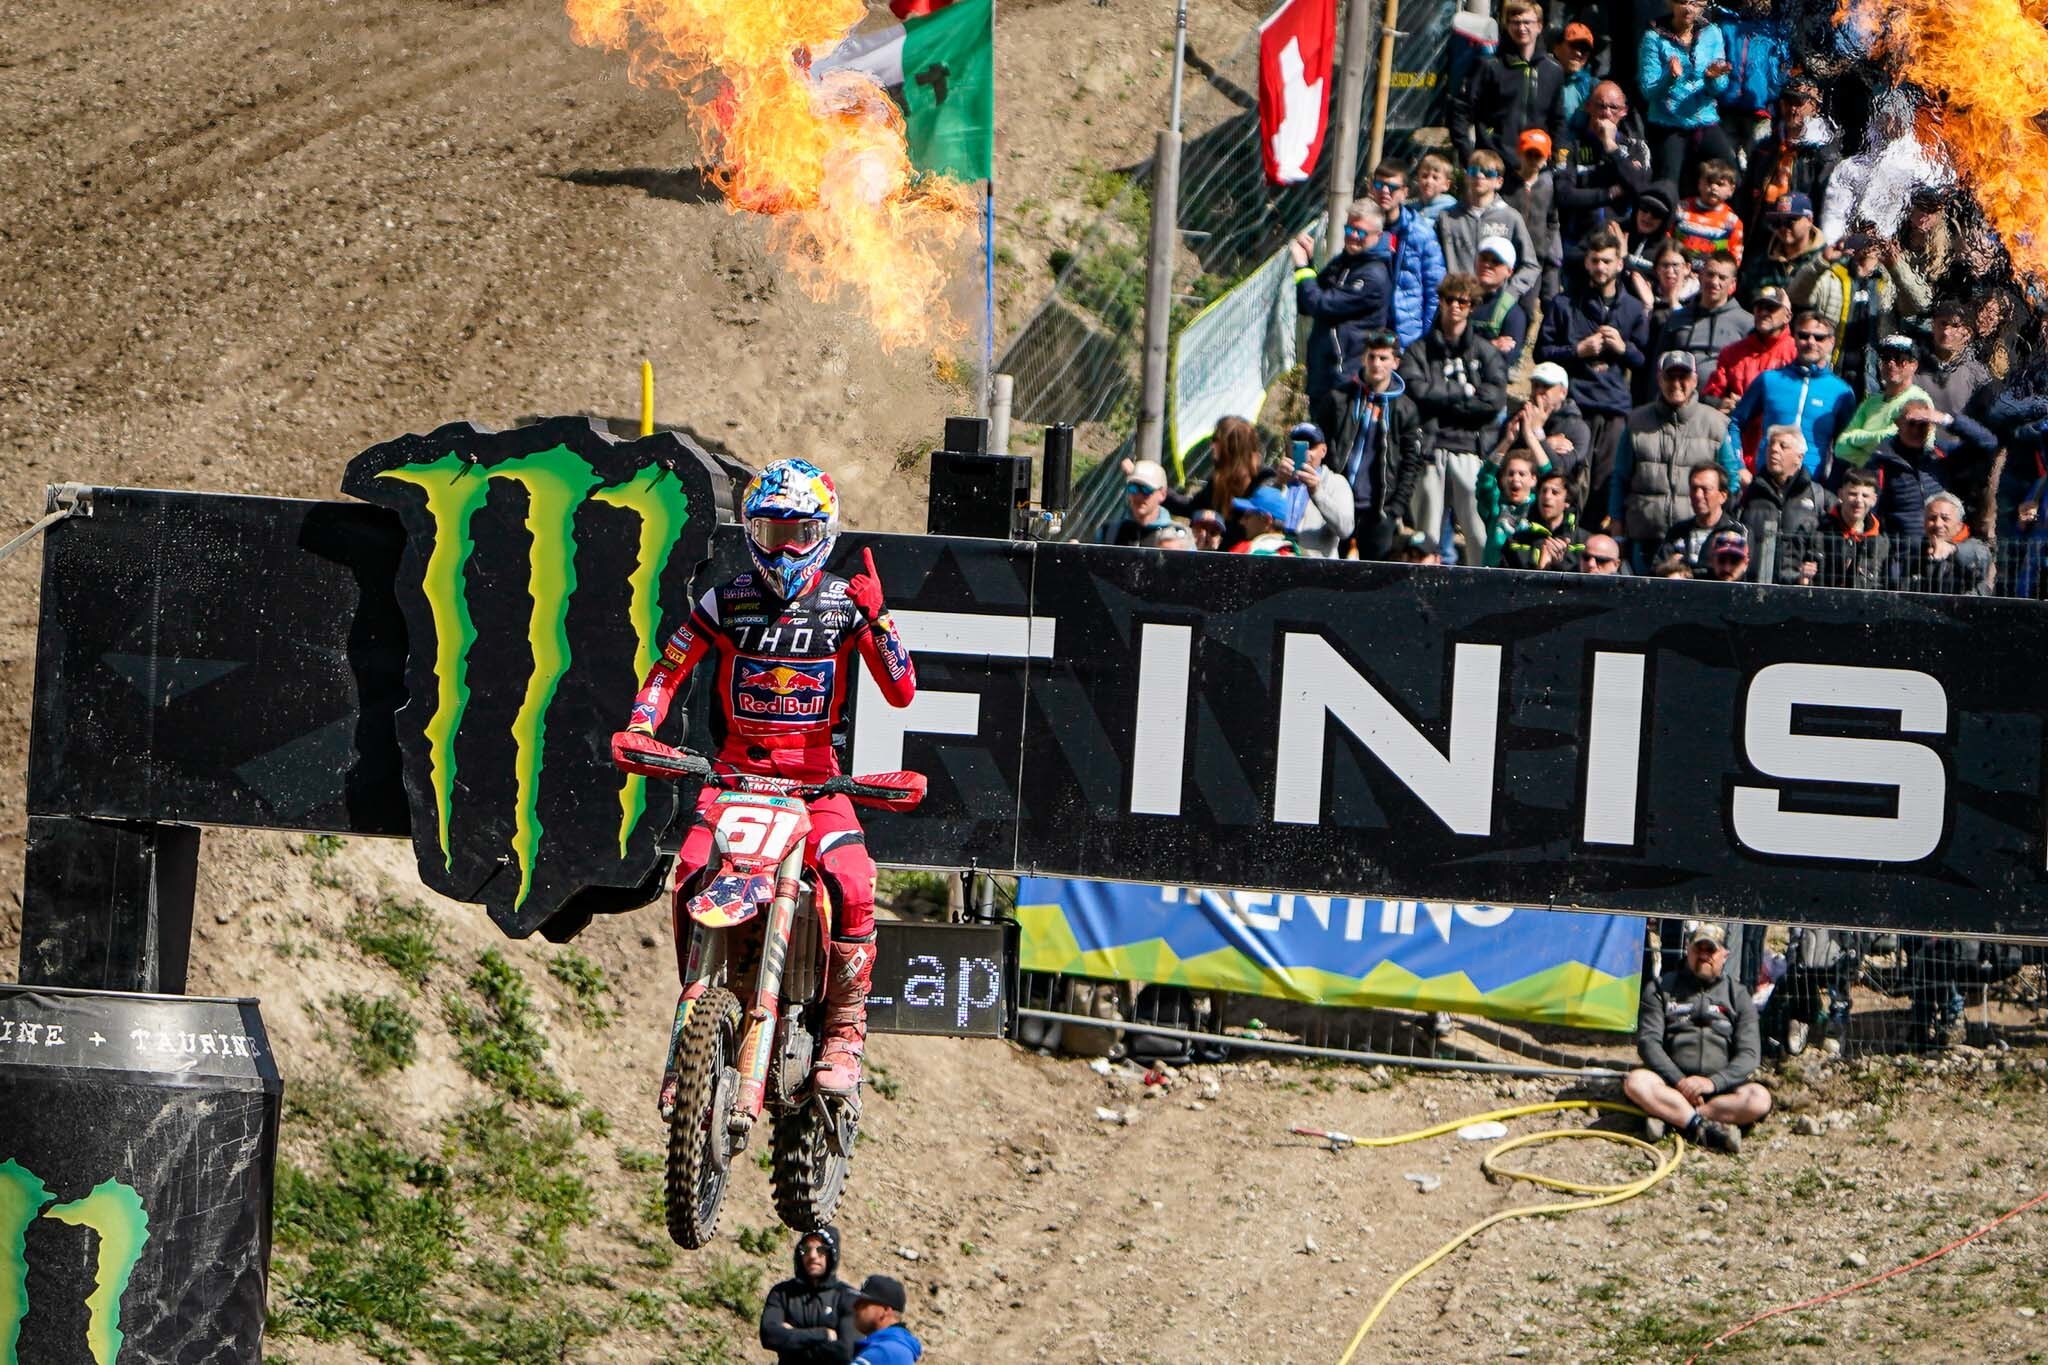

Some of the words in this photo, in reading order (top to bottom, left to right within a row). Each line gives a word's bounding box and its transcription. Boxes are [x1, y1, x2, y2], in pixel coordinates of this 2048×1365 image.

[739, 693, 782, 714] Red
[783, 695, 825, 716] Bull
[852, 610, 2048, 870] FINIS
[715, 806, 801, 861] 61
[130, 1027, 262, 1058] TAURINE
